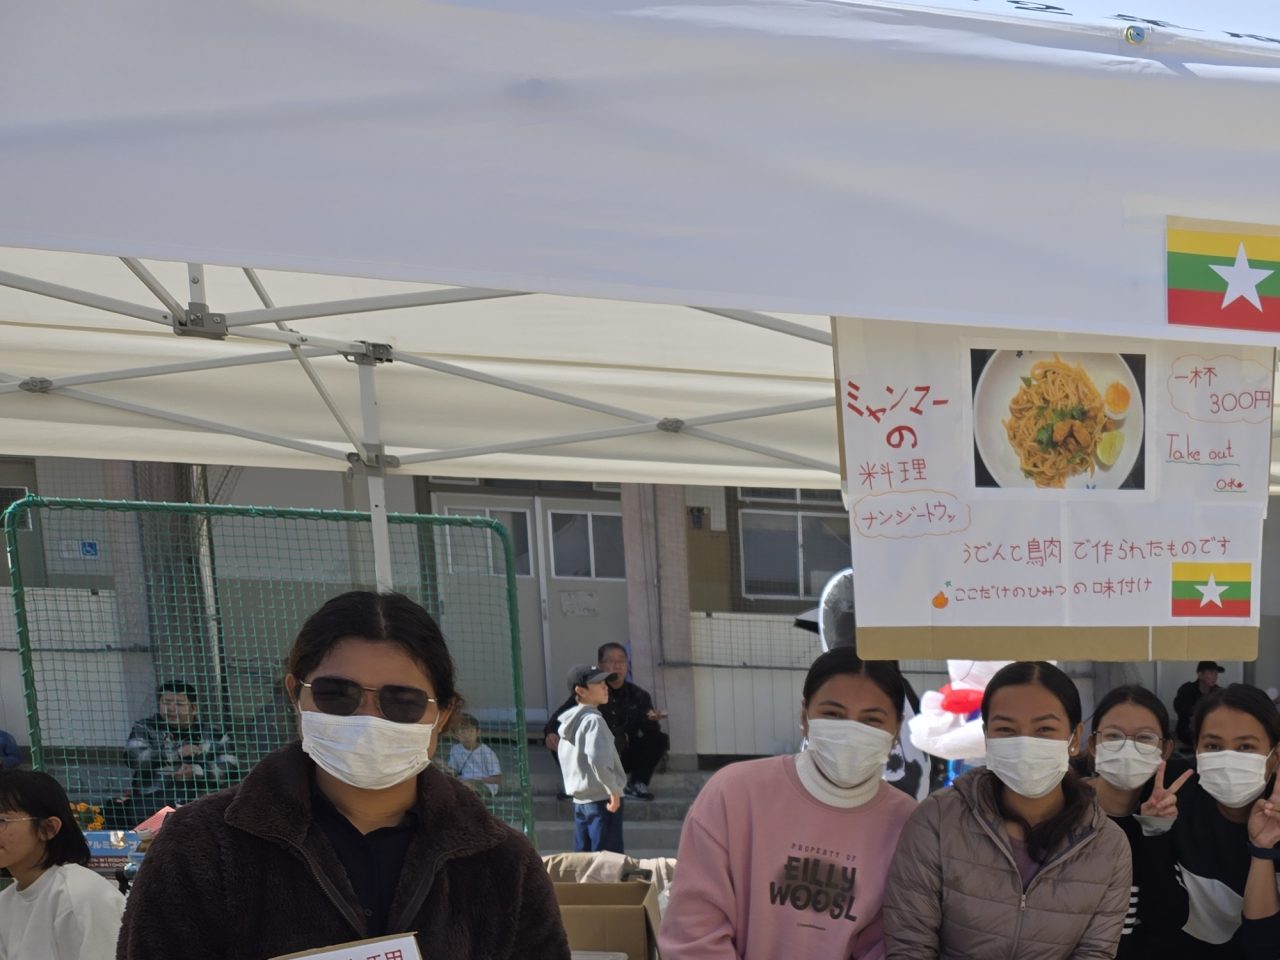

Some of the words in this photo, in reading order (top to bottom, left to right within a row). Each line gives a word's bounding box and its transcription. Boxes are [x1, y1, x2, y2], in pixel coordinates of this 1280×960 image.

[1175, 366, 1217, 388] 一杯
[847, 380, 949, 423] ミャンマー
[1209, 390, 1271, 414] 300円
[886, 425, 917, 449] の
[1166, 433, 1201, 461] Take
[1208, 439, 1235, 461] out
[859, 459, 927, 491] 料理
[791, 843, 839, 857] PROPERTY
